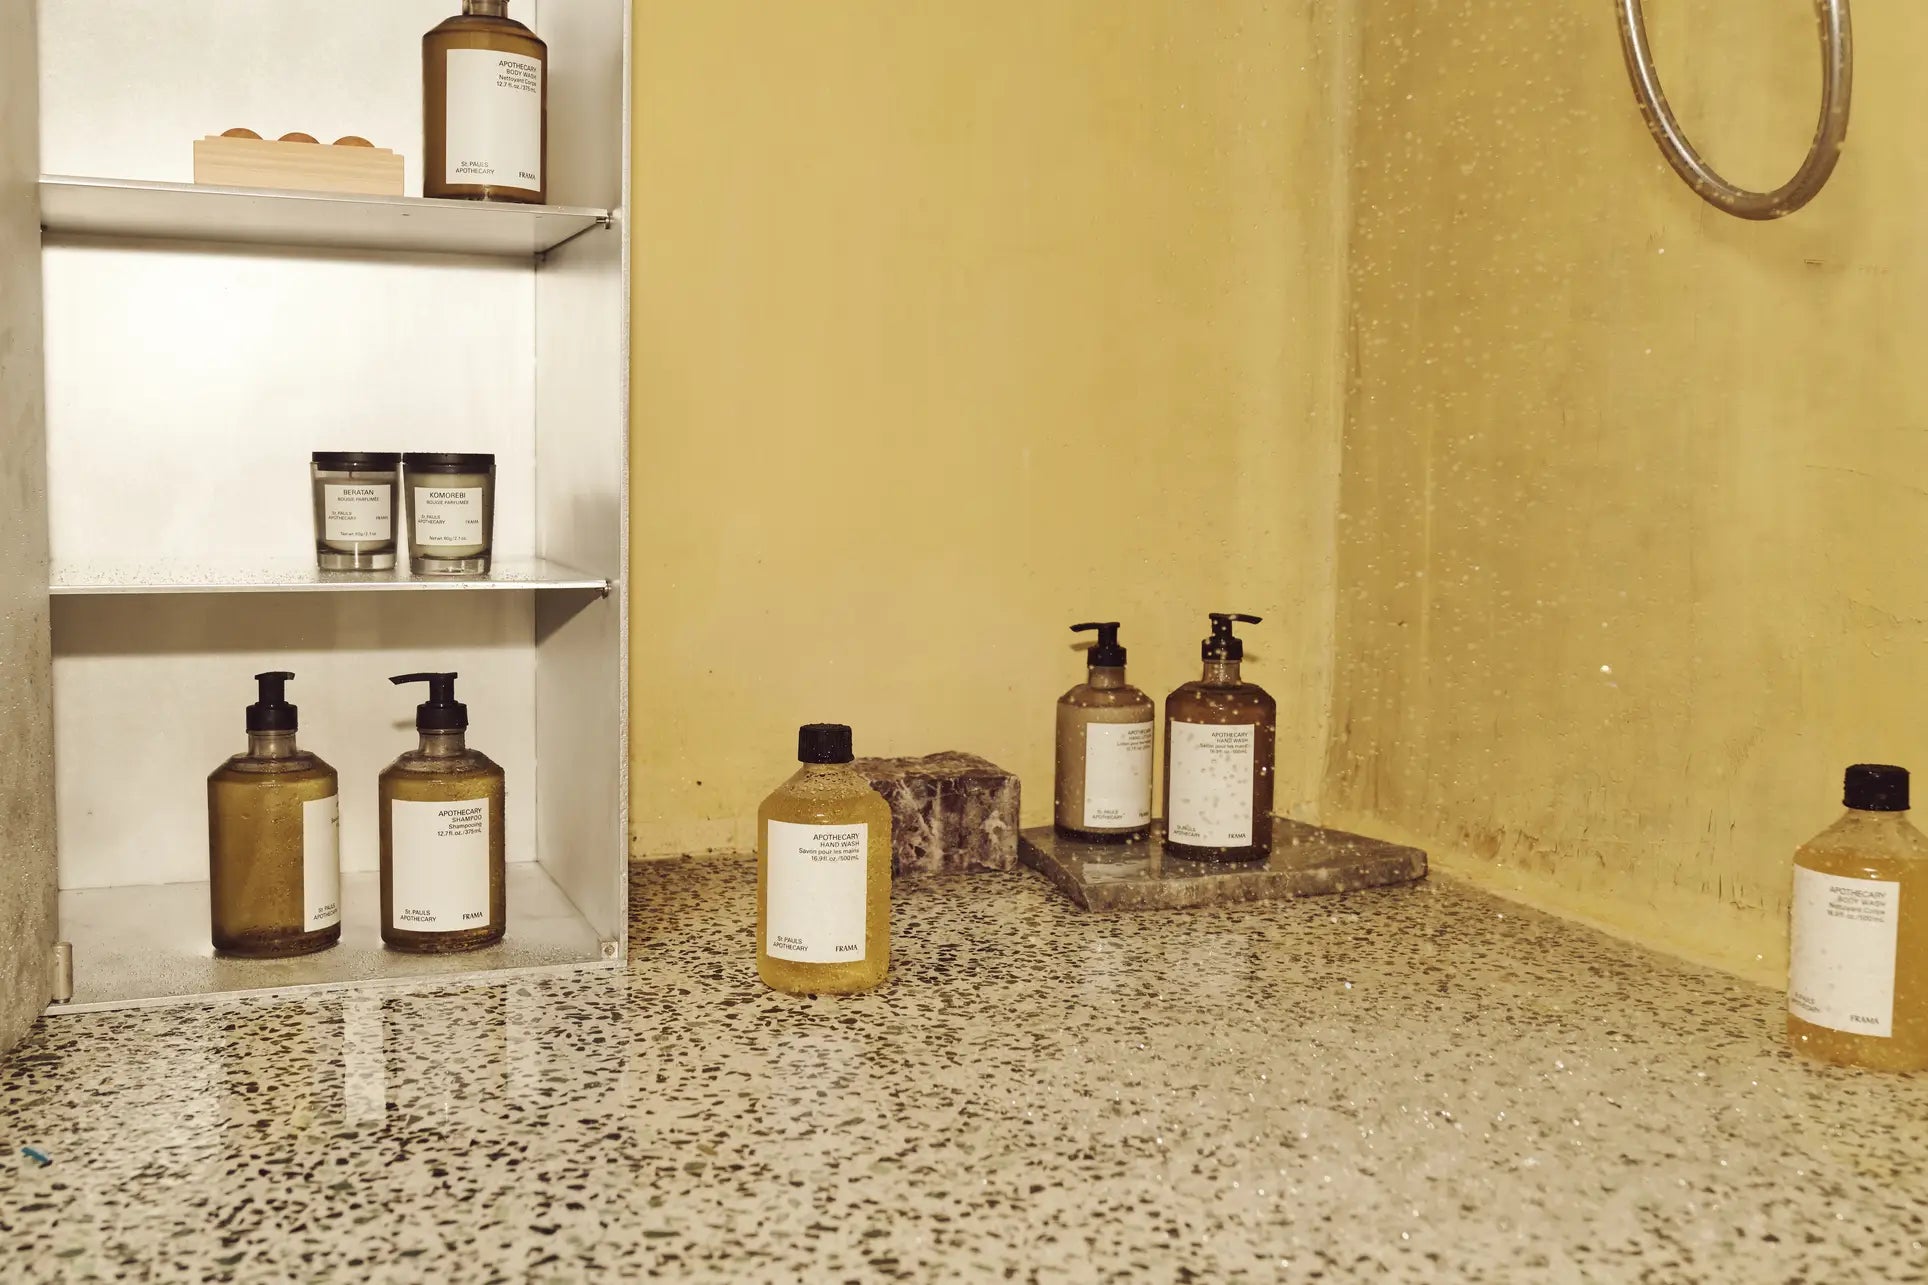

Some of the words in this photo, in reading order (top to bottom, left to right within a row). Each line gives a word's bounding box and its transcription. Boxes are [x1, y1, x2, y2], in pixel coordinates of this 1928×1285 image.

[498, 60, 536, 72] APOTHECARY
[519, 172, 536, 180] FRAMA
[438, 808, 482, 816] APOTHECARY
[452, 814, 482, 822] SHAMPOO
[1830, 886, 1886, 899] APOTHECARY
[462, 912, 482, 920] FRAMA
[773, 942, 808, 952] APOTHECARY
[1850, 1014, 1880, 1024] FRAMA
